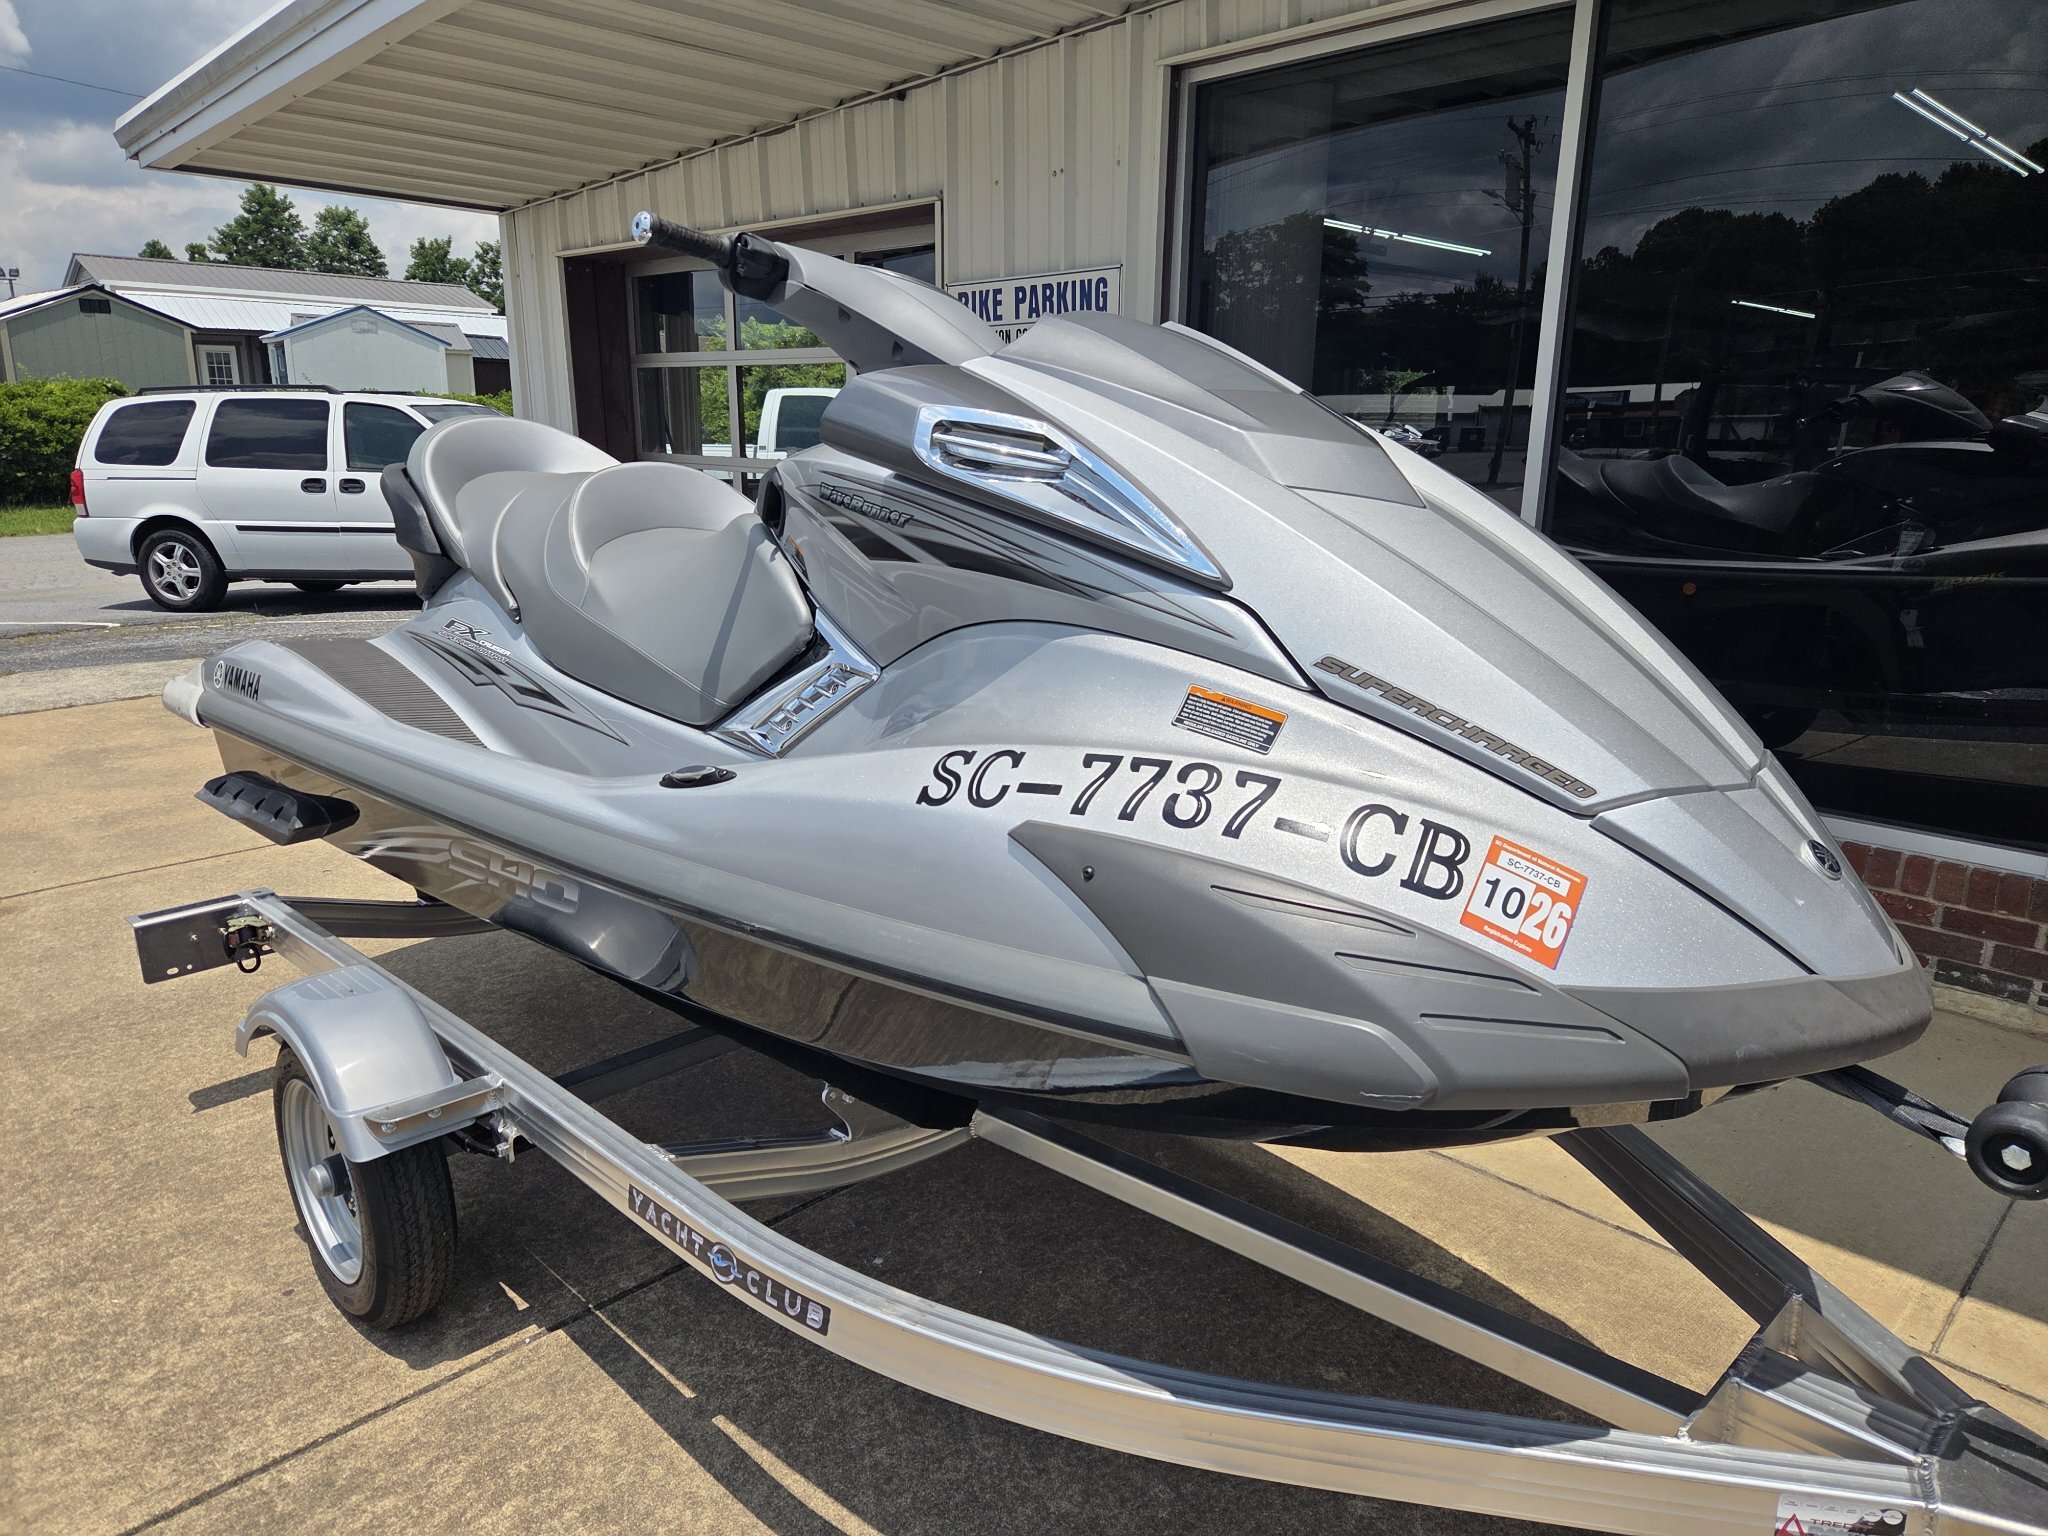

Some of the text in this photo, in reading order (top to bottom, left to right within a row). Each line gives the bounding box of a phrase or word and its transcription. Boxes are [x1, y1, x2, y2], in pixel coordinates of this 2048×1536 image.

[1014, 277, 1108, 320] PARKING
[442, 617, 491, 643] FX
[224, 663, 261, 701] YAMAHA
[1313, 656, 1597, 799] SUPERCHARGED
[1507, 857, 1561, 889] SC-7737-CB
[1484, 877, 1572, 949] 10 26
[632, 1188, 824, 1329] YACHT CLUB
